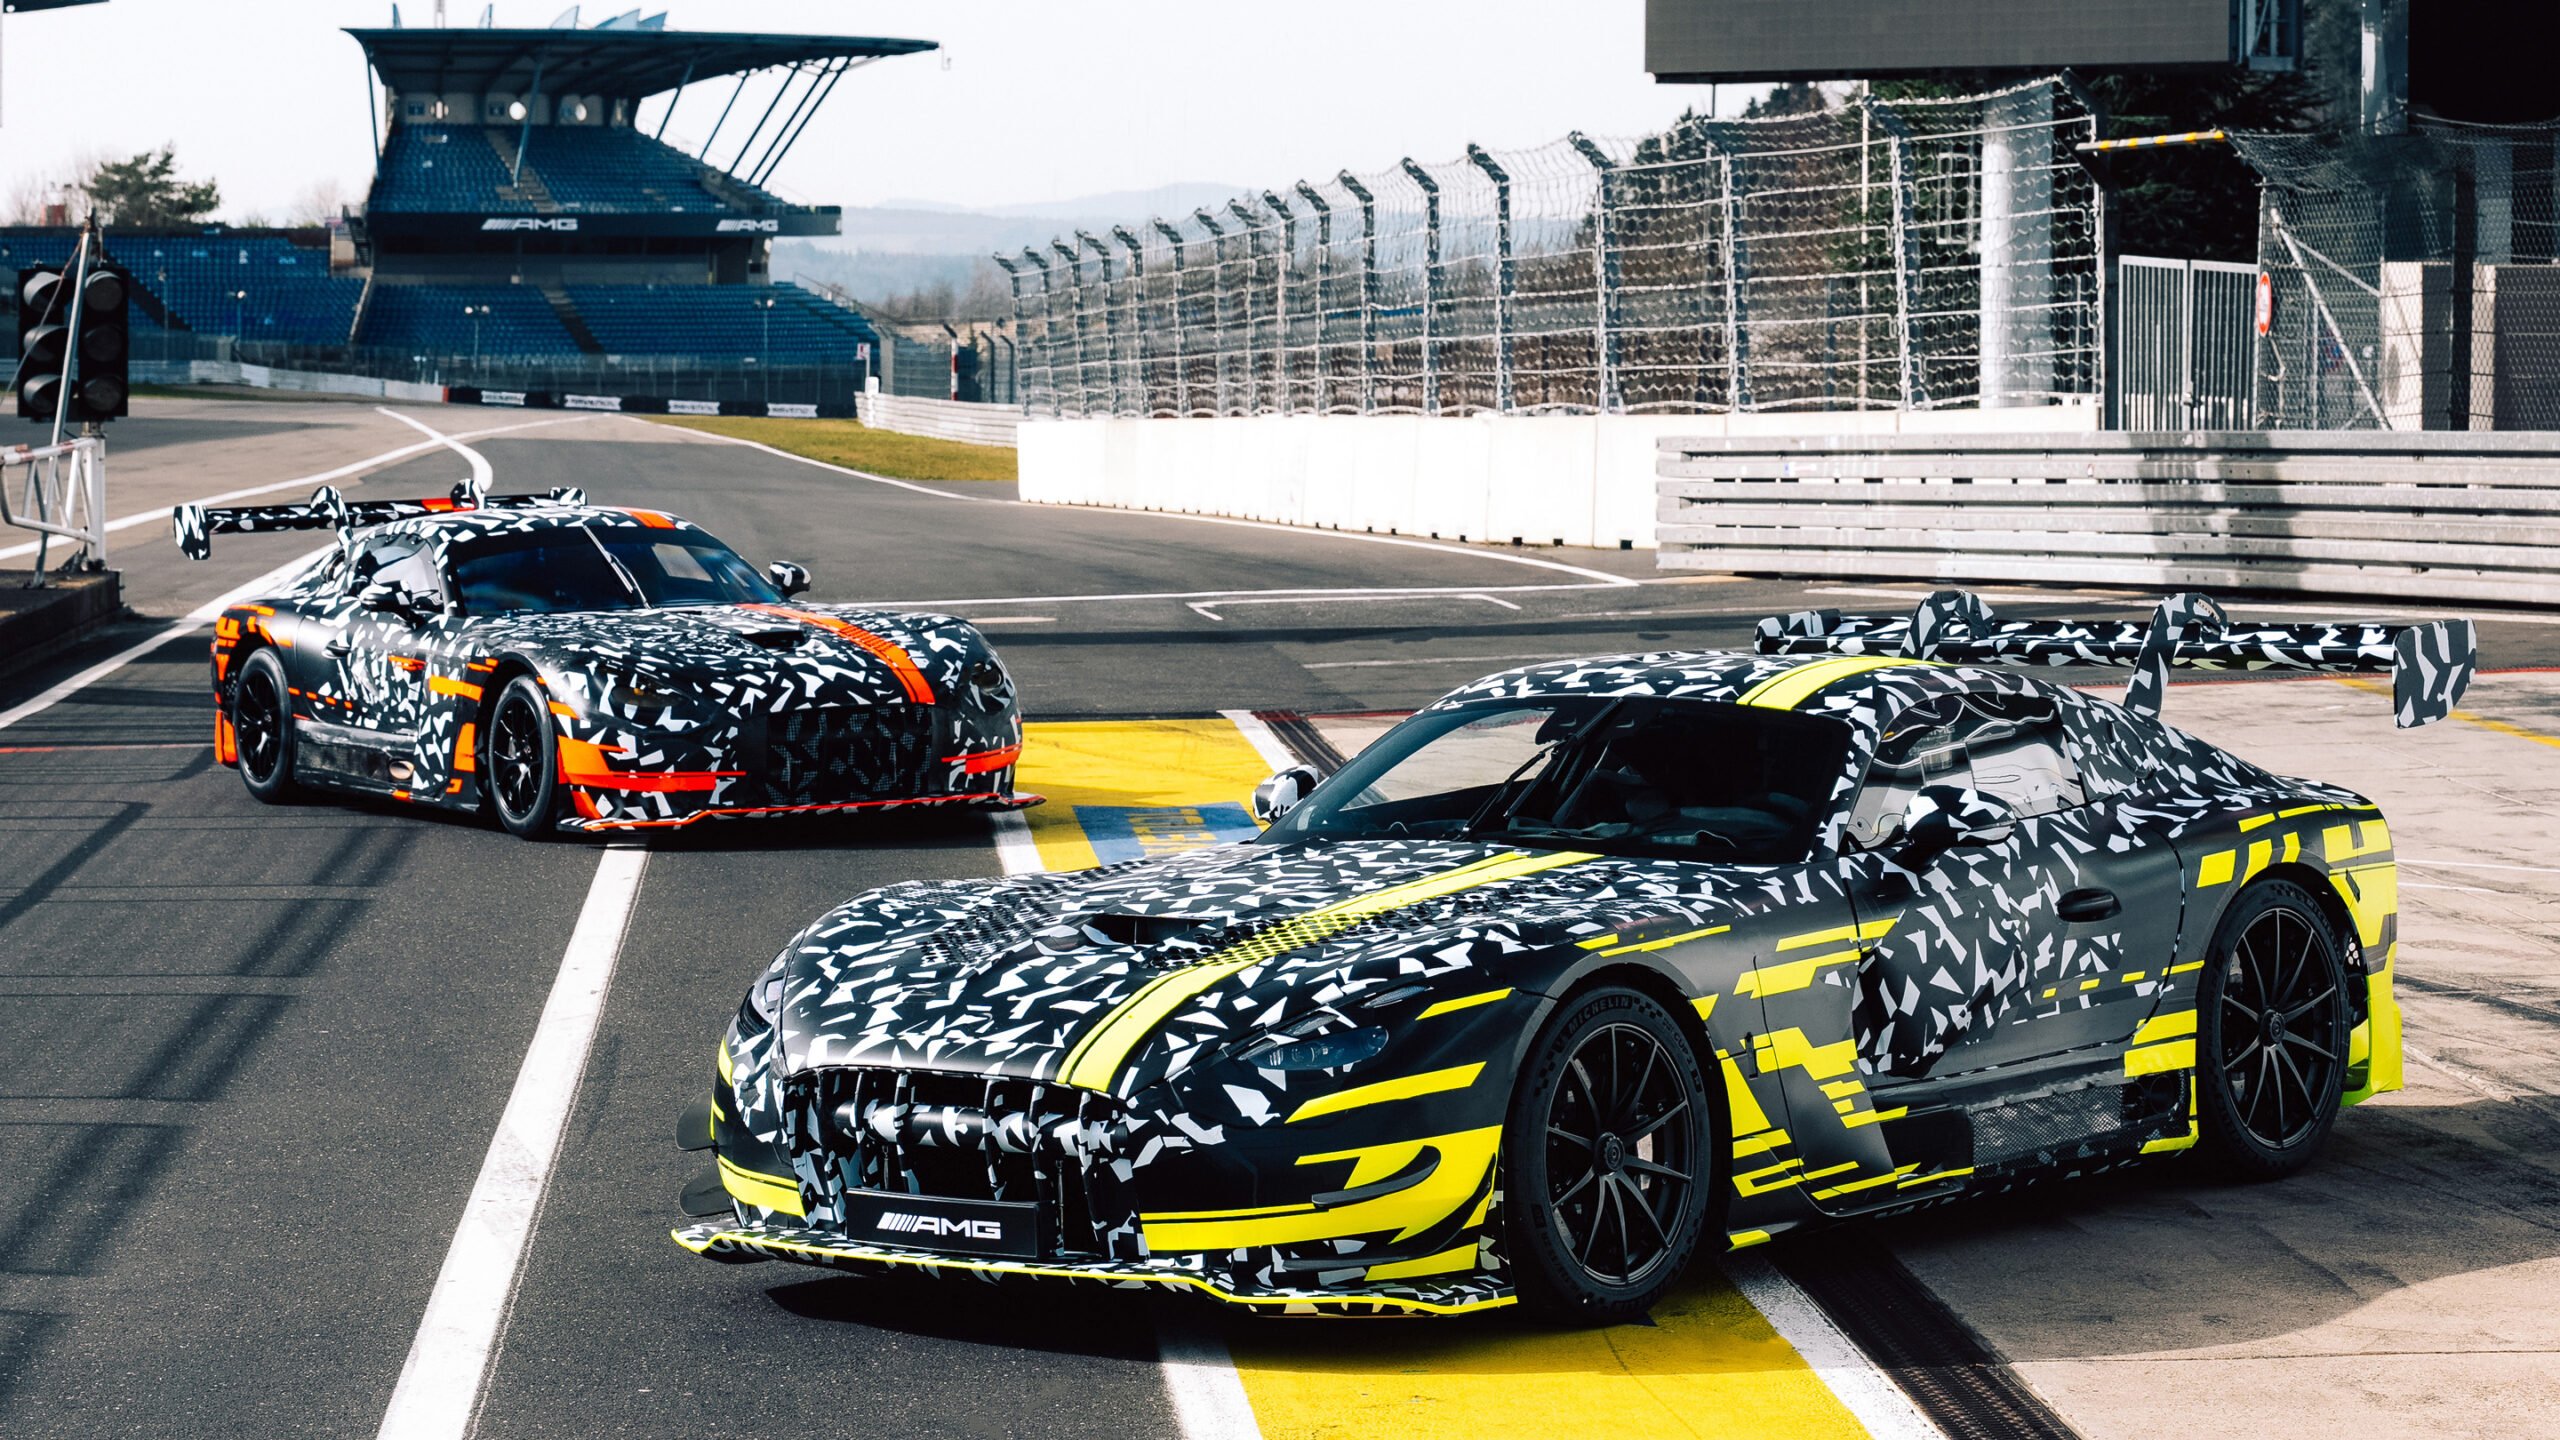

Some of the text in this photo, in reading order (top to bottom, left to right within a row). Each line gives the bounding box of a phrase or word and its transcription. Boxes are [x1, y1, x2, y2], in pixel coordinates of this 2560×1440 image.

[511, 218, 578, 231] AMG
[738, 219, 779, 232] AMG
[1567, 995, 1632, 1035] MICHELIN
[911, 1215, 1002, 1240] AMG
